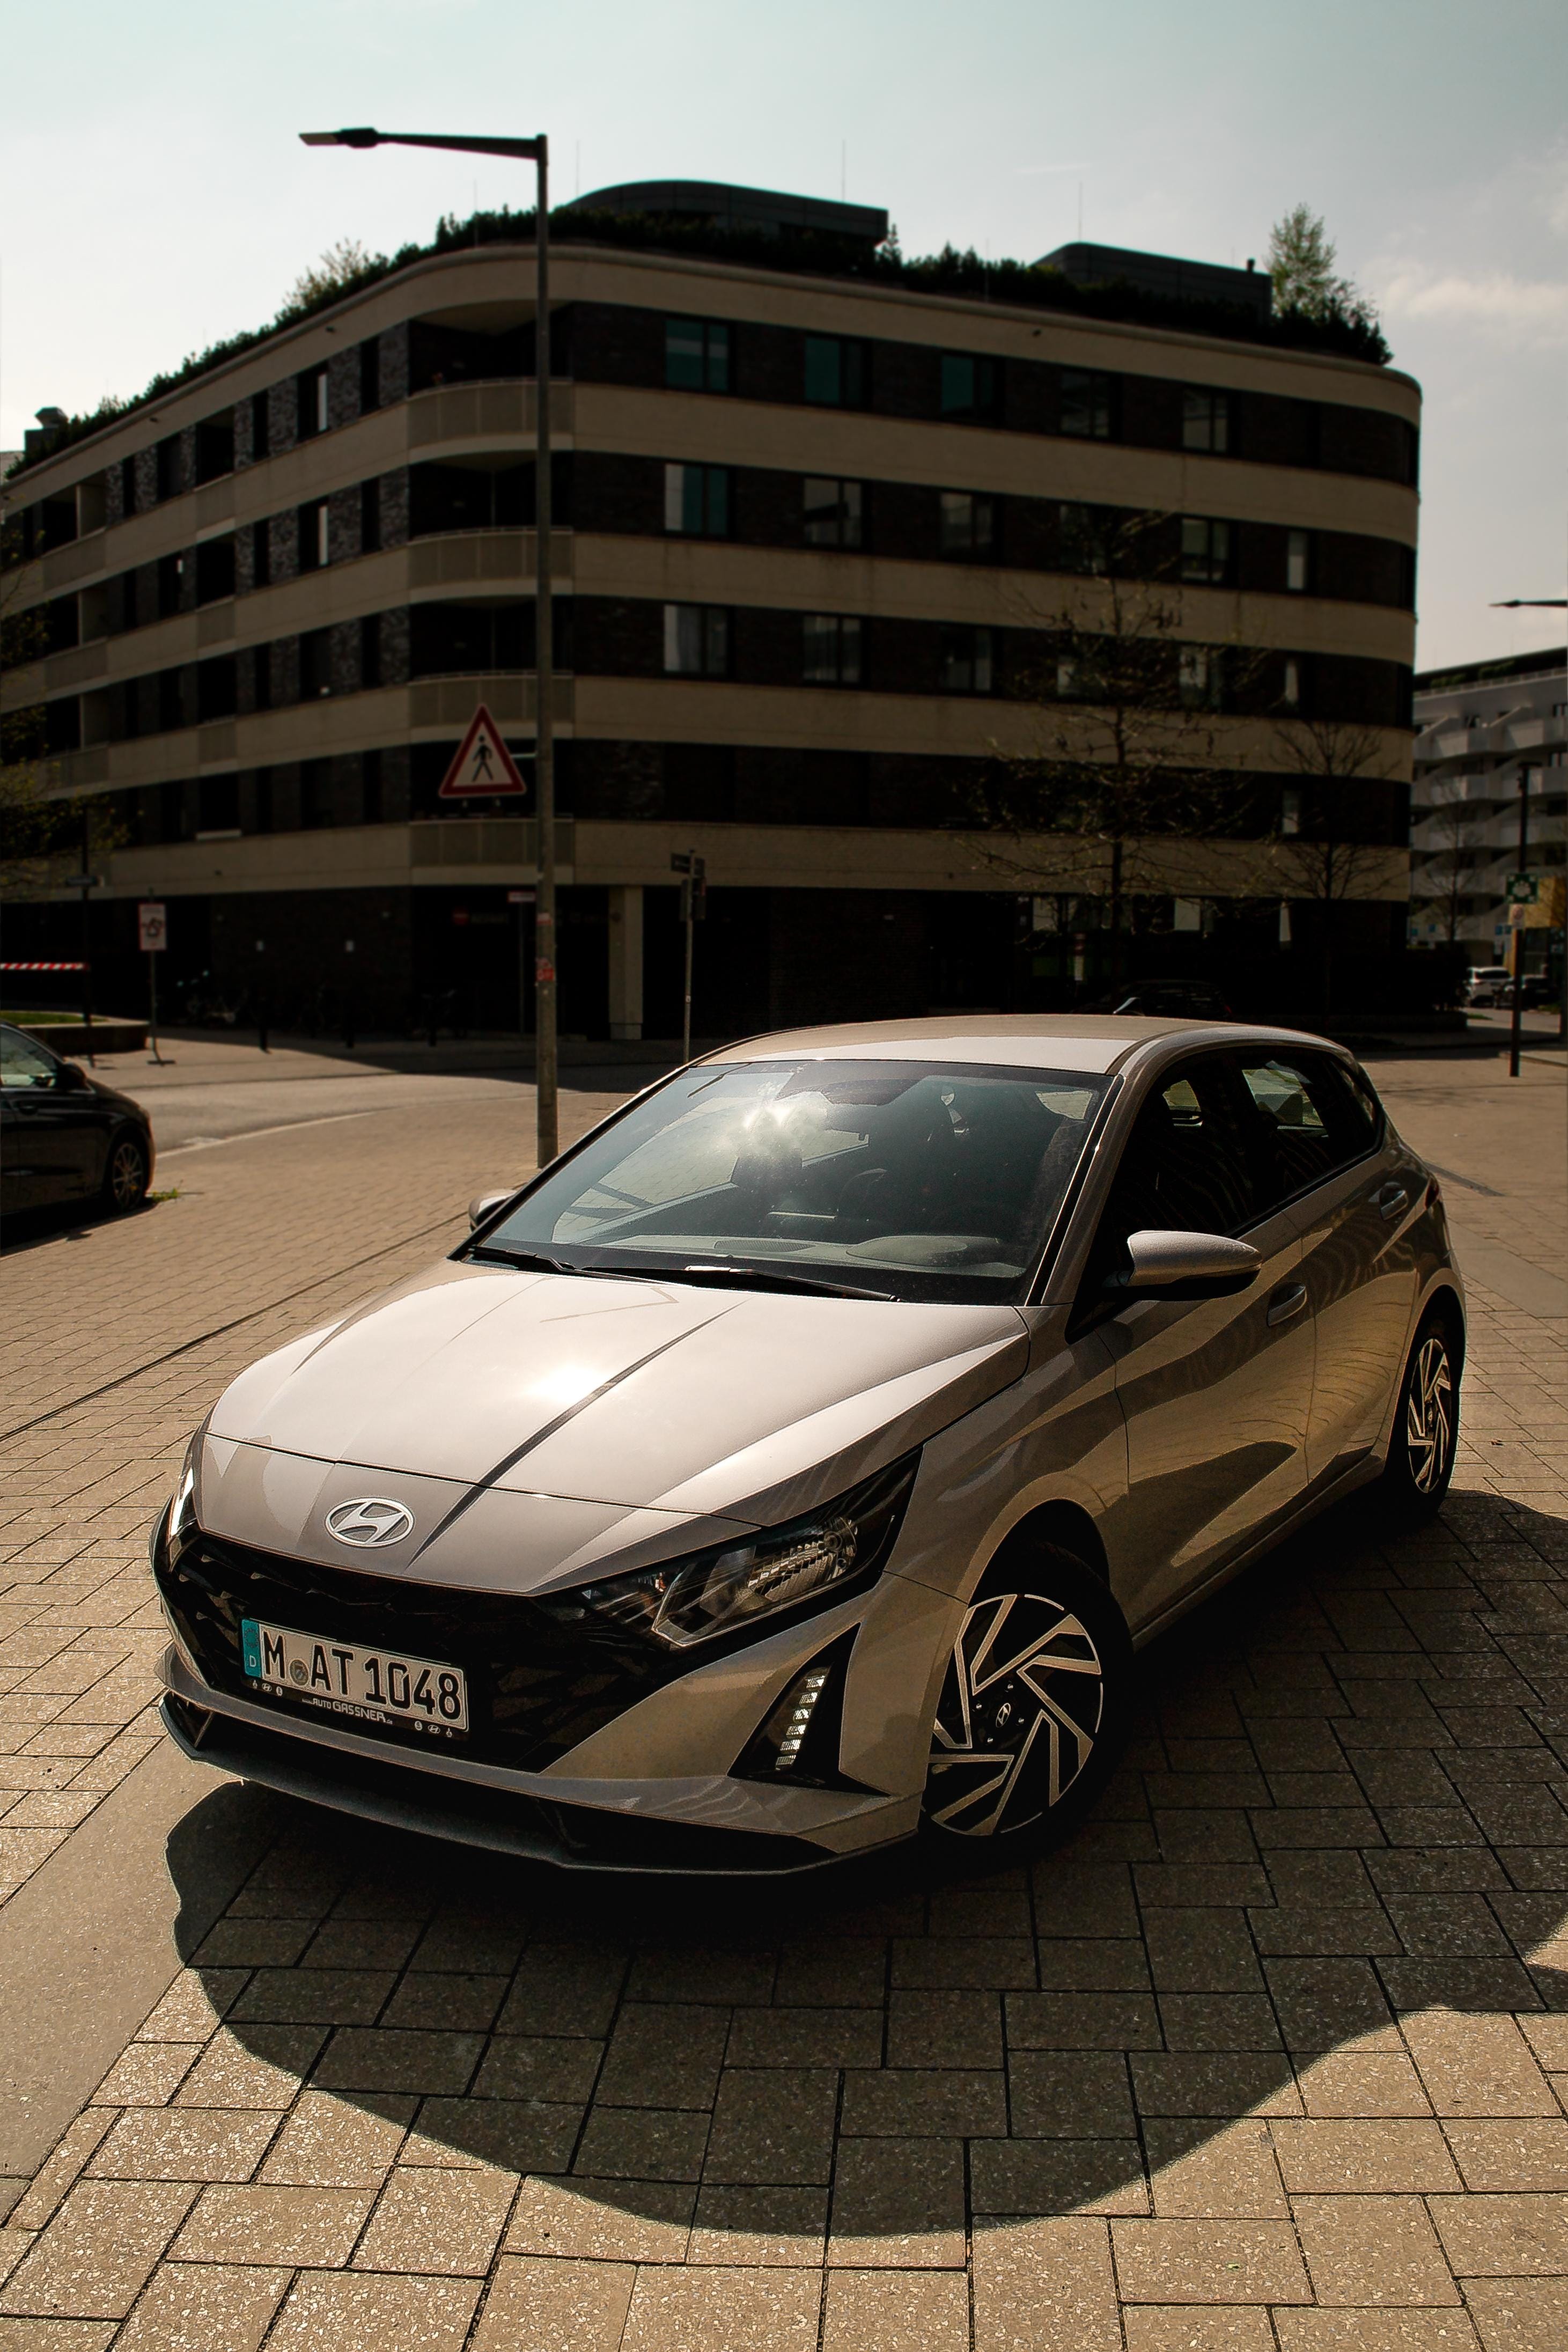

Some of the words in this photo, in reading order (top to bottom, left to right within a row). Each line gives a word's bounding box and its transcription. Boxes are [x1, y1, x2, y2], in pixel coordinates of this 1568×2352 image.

[249, 1655, 256, 1667] D
[263, 1631, 285, 1679] M
[311, 1644, 354, 1695] AT
[365, 1657, 461, 1720] 1048
